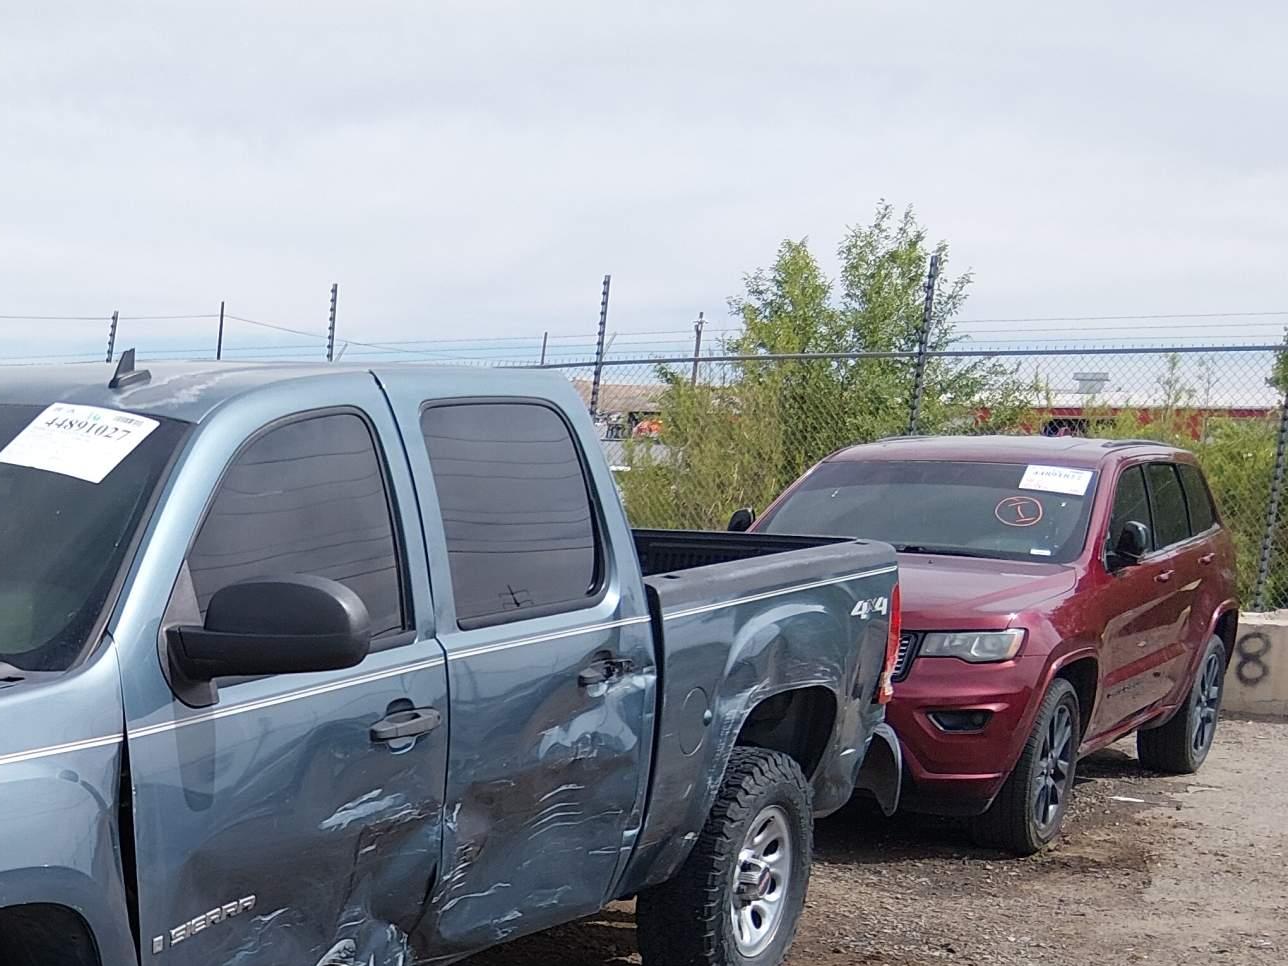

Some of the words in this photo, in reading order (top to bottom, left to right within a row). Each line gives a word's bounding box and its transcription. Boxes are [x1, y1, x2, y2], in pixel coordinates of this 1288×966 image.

[45, 417, 132, 441] 44891027
[1235, 631, 1271, 686] 8
[169, 893, 257, 947] SIERRA
